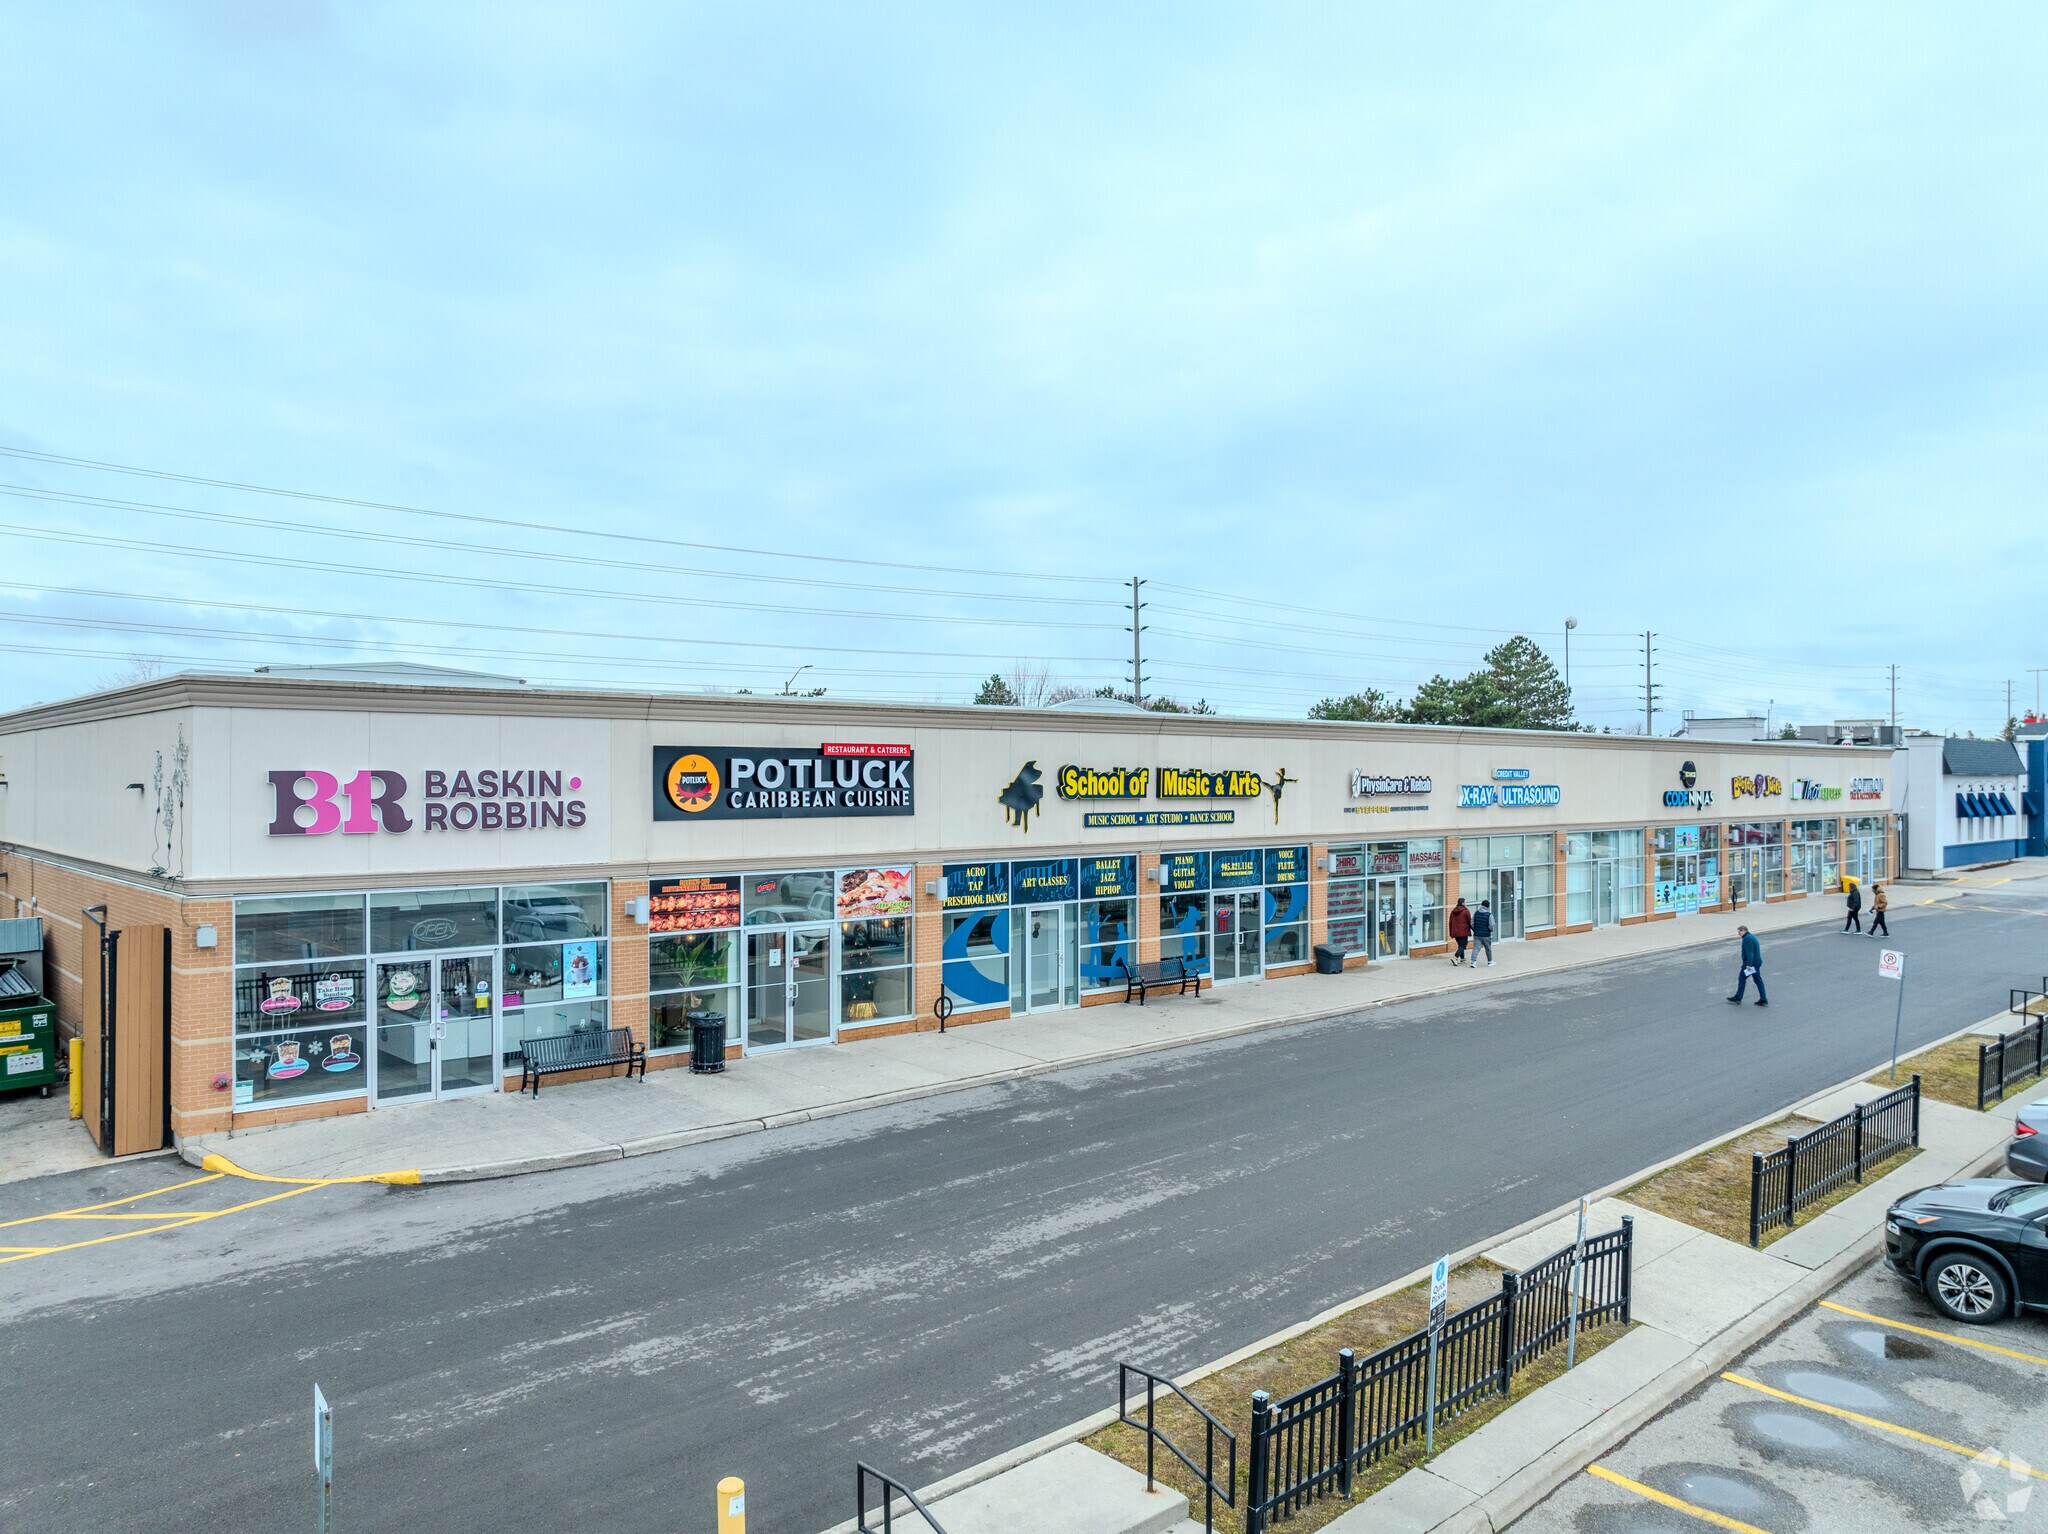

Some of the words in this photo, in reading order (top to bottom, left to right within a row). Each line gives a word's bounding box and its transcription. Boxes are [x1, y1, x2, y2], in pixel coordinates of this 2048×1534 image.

[827, 745, 869, 755] RESTAURANT
[870, 746, 876, 754] &
[876, 746, 908, 755] CATERERS
[730, 758, 911, 789] POTLUCK
[1497, 770, 1512, 778] CREDIT
[1513, 770, 1529, 778] VALLEY
[424, 769, 563, 799] BASKIN
[681, 775, 708, 785] POTLUCK
[1065, 768, 1125, 797] School
[1129, 770, 1148, 796] of
[1163, 770, 1210, 796] Music
[1215, 777, 1225, 795] &
[1228, 771, 1260, 796] Arts
[1361, 777, 1403, 794] PhysioCare
[1410, 777, 1431, 792] Rehab
[730, 790, 836, 809] CARIBBEAN
[844, 789, 910, 808] CUISINE
[1502, 787, 1560, 805] ULTRASOUND
[1355, 805, 1391, 814] STEPPERS
[423, 800, 588, 833] ROBBINS
[1088, 814, 1110, 826] MUSIC
[1110, 813, 1138, 826] SCHOOL
[1144, 813, 1158, 824] ART
[1159, 813, 1183, 824] STUDIO
[1189, 812, 1209, 823] DANCE
[1209, 811, 1234, 823] SCHOOL
[1278, 850, 1294, 859] VOICE
[1374, 853, 1400, 864] PHYSIO
[1409, 851, 1441, 862] MASSAGE
[1096, 860, 1121, 870] BALLET
[1174, 856, 1194, 865] PIANO
[1277, 861, 1295, 870] FLUTE
[966, 867, 986, 877] ACRO
[1100, 872, 1116, 883] JAZZ
[1173, 868, 1196, 878] GUITAR
[1277, 872, 1295, 882] DRUMS
[757, 882, 777, 893] OPEN
[968, 881, 984, 891] TAP
[1022, 878, 1036, 888] ART
[1038, 876, 1068, 886] CLASSES
[1173, 880, 1195, 890] VIOLIN
[1095, 885, 1122, 896] HIPHOP
[943, 895, 985, 907] PRESCHOOL
[985, 893, 1008, 904] DANCE
[415, 922, 457, 937] OPEN
[1432, 1281, 1446, 1295] Quick
